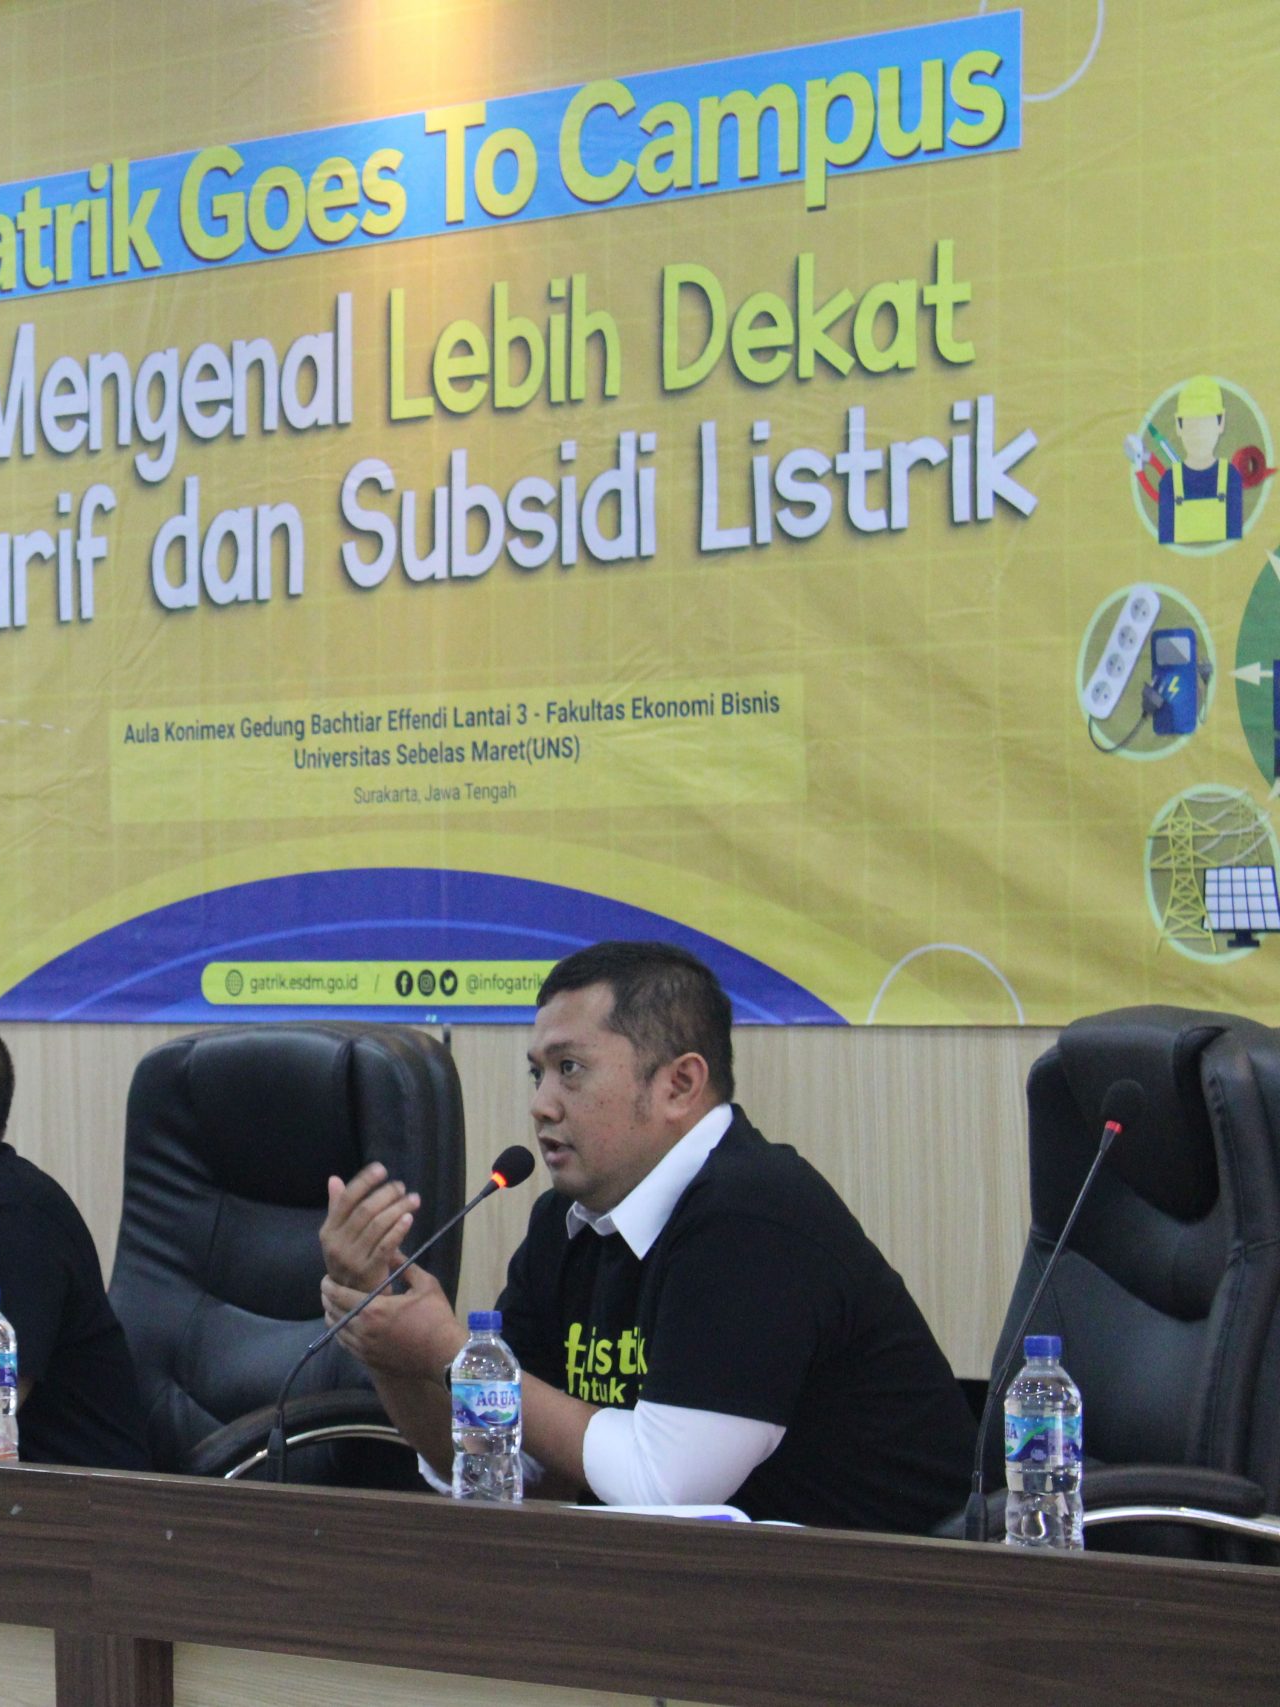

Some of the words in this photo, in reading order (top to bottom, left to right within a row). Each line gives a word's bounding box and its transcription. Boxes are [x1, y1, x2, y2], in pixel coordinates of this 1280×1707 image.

[179, 145, 407, 261] Goes
[424, 101, 537, 224] To
[559, 50, 1006, 210] Campus
[390, 274, 620, 420] Lebih
[663, 239, 977, 391] Dekat
[152, 476, 304, 609] dan
[341, 430, 657, 588] Subsidi
[700, 394, 1039, 552] Listrik
[124, 722, 160, 744] Aula
[165, 719, 235, 742] Konimex
[240, 715, 305, 741] Gedung
[311, 711, 382, 735] Bachtiar
[388, 706, 447, 731] Effendi
[453, 704, 511, 729] Lantai
[516, 703, 527, 725] 3
[546, 698, 625, 724] Fakultas
[631, 693, 714, 720] Ekonomi
[721, 690, 780, 716] Bisnis
[294, 744, 391, 769] Universitas
[397, 741, 465, 765] Sebelas
[472, 735, 580, 765] Maret(UNS)
[424, 783, 460, 802] Jawa
[464, 780, 517, 804] Tengah
[250, 974, 358, 994] gatrik.esdm.go.id
[476, 1390, 516, 1409] AQUA
